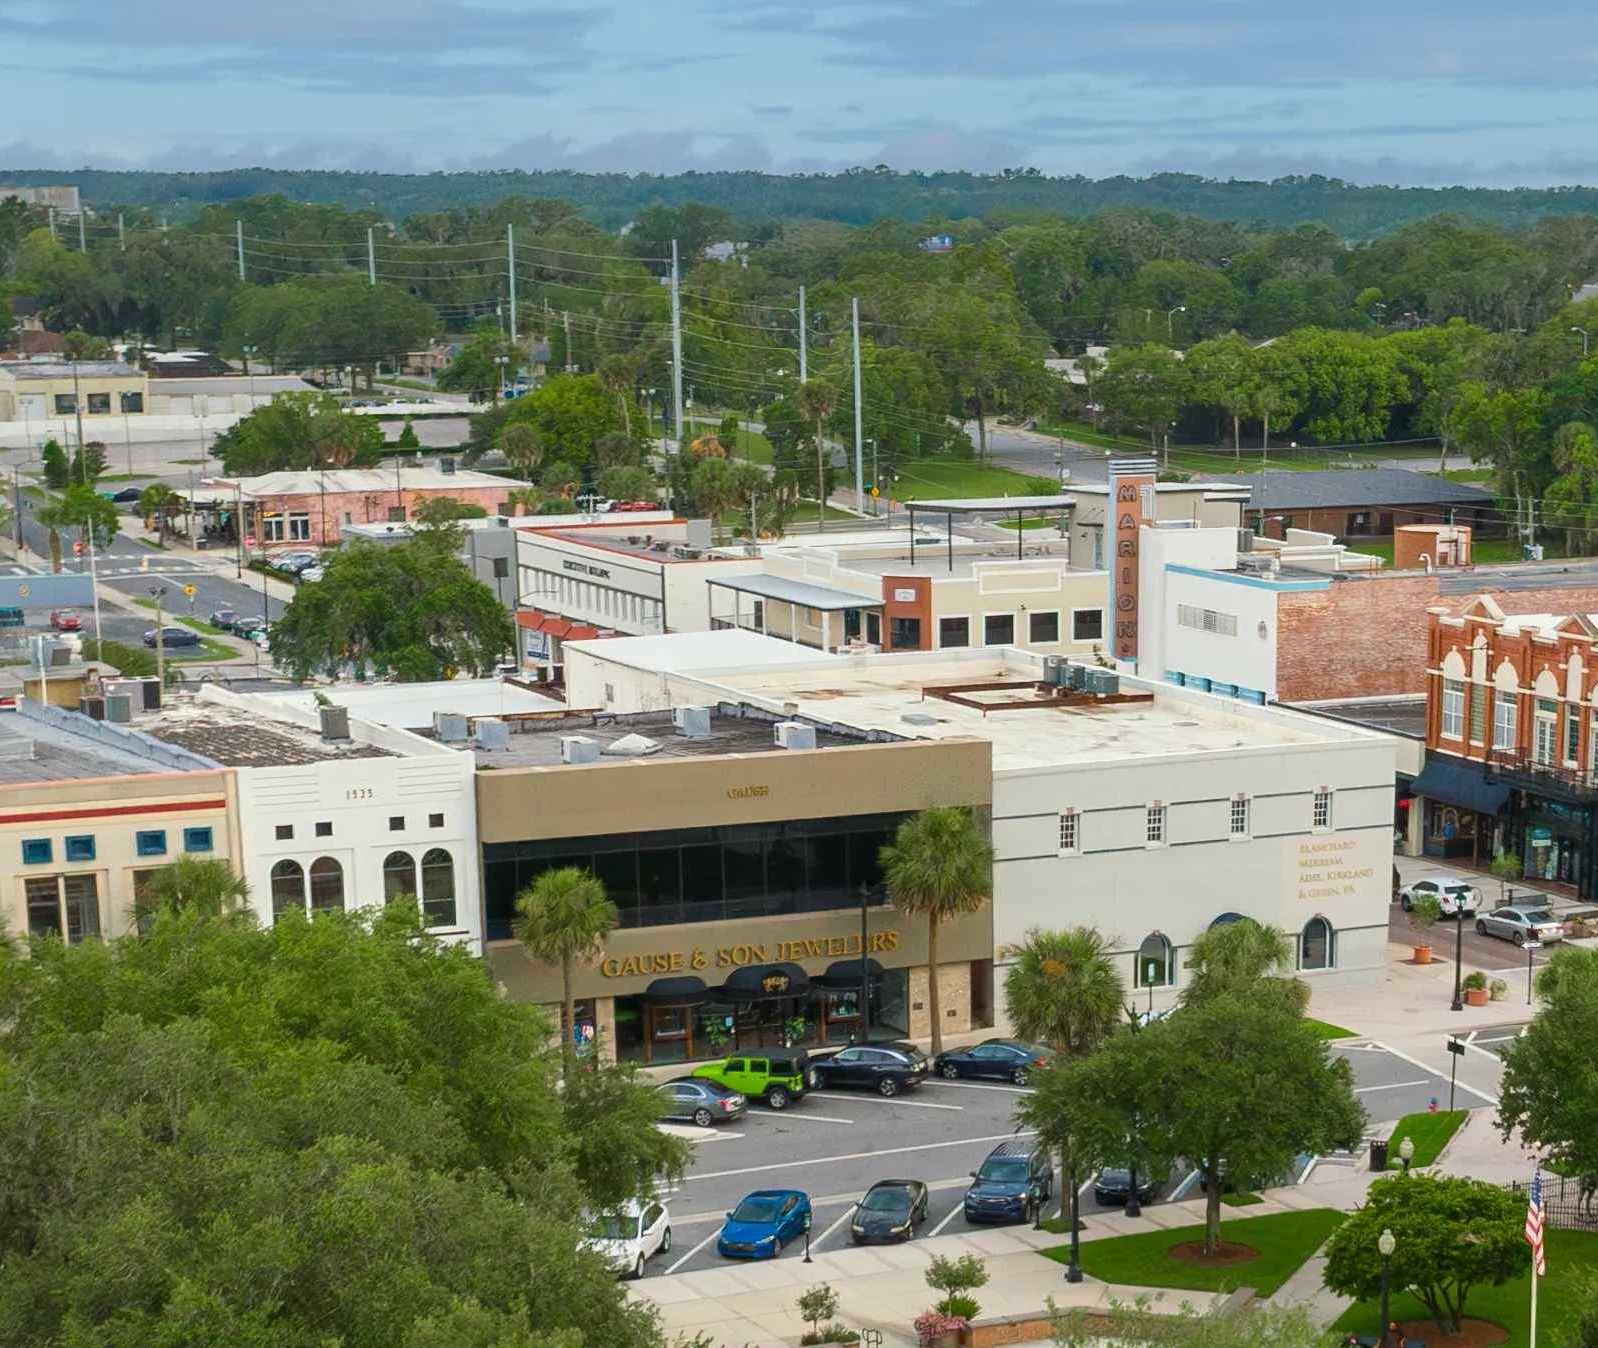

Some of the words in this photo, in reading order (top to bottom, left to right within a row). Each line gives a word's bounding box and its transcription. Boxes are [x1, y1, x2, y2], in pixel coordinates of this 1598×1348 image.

[1118, 484, 1138, 639] MARION
[603, 952, 683, 977] GAUSE
[691, 945, 709, 969] &
[717, 944, 767, 968] SON
[776, 929, 899, 961] JEWELERS
